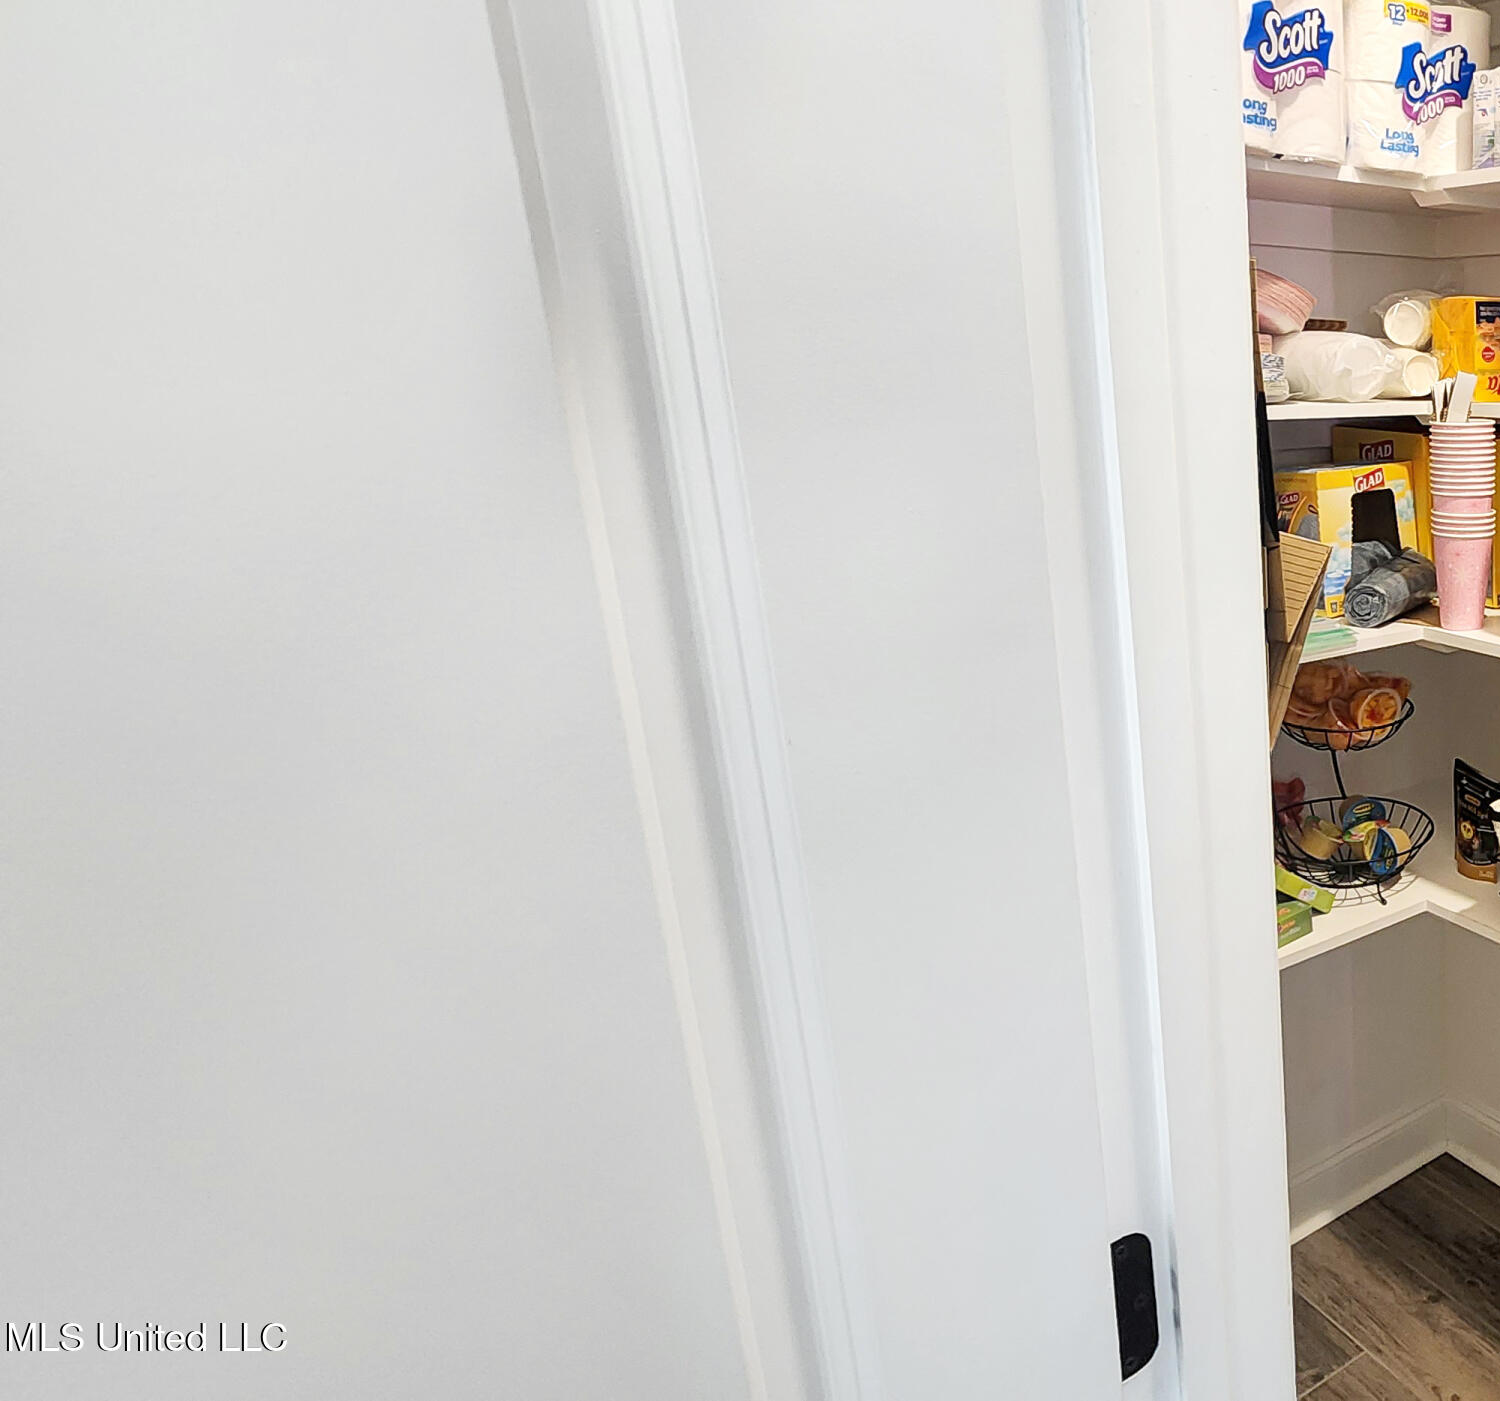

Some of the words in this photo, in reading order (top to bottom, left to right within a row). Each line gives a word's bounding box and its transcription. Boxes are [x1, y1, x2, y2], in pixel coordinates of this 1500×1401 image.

[1259, 9, 1323, 63] Scott
[1273, 66, 1306, 94] 1000
[1408, 47, 1464, 100] Scott
[1243, 99, 1268, 114] ong
[1243, 113, 1278, 132] sting
[1385, 128, 1415, 143] Long
[1362, 443, 1393, 461] GLAD
[1354, 471, 1384, 493] GLAD
[1279, 494, 1299, 506] GLAD
